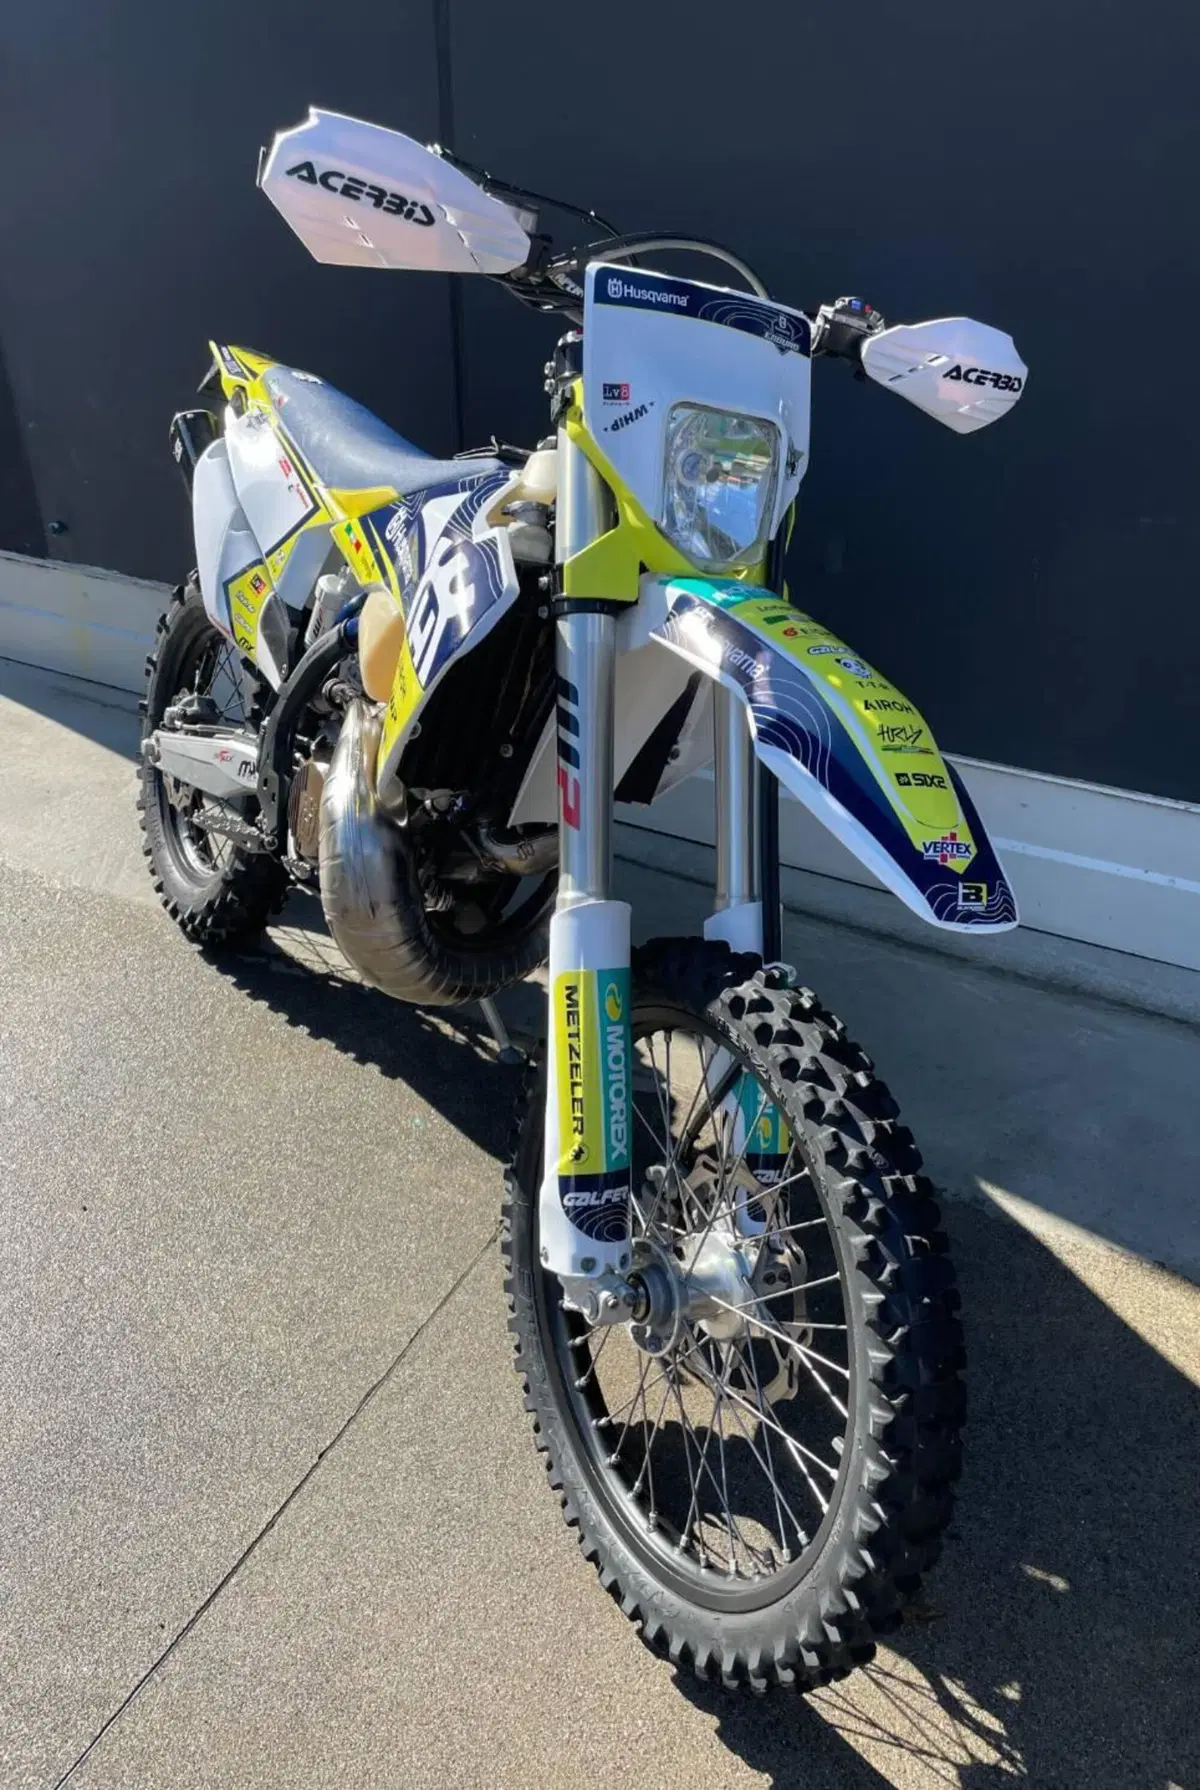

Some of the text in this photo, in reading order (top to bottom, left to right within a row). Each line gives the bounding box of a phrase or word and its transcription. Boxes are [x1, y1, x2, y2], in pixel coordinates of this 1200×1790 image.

[624, 284, 689, 307] Husqvarna
[611, 404, 648, 431] WHIP
[922, 841, 972, 855] VERTEX
[564, 984, 585, 1136] METZELER
[605, 1024, 629, 1161] MOTOREX
